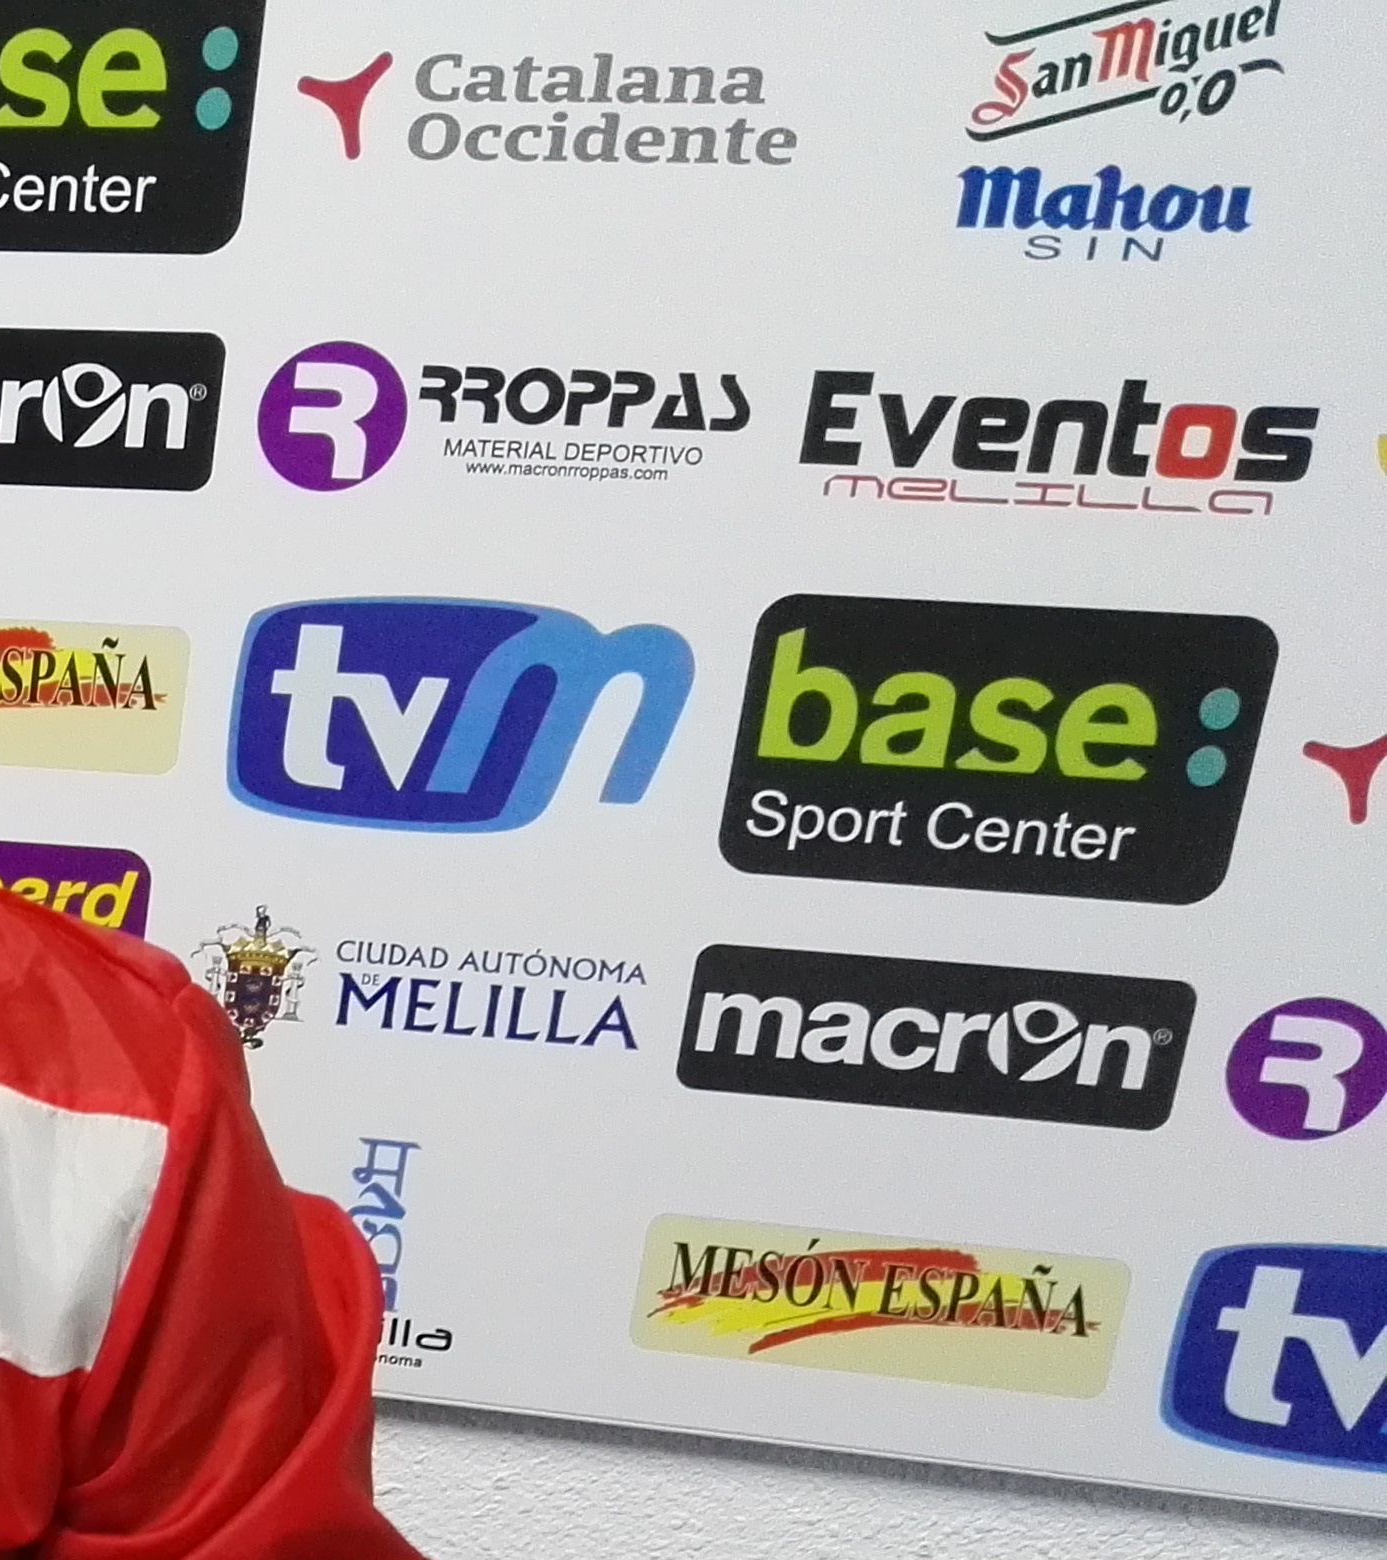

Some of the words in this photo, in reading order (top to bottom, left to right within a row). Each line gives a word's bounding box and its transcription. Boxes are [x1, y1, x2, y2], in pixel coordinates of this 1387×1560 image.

[414, 52, 766, 105] Catalana
[407, 111, 798, 166] Occidente
[955, 164, 1253, 234] Mahou
[1023, 234, 1165, 262] SIN
[419, 364, 752, 433] RROPPAS
[799, 370, 1321, 483] Eventos
[443, 438, 557, 462] MATERIAL
[564, 441, 704, 466] DEPORTIVO
[465, 462, 669, 482] www.macronrroppas.com
[757, 627, 1159, 782] base
[745, 788, 907, 851] Sport
[926, 801, 1136, 862] Center
[335, 940, 448, 971] CIUDAD
[459, 946, 648, 986] AUTÓNOMA
[361, 973, 381, 988] DE
[335, 971, 639, 1052] MELILLA
[667, 1237, 861, 1317] MESÓN
[880, 1262, 1094, 1339] ESPAÑA
